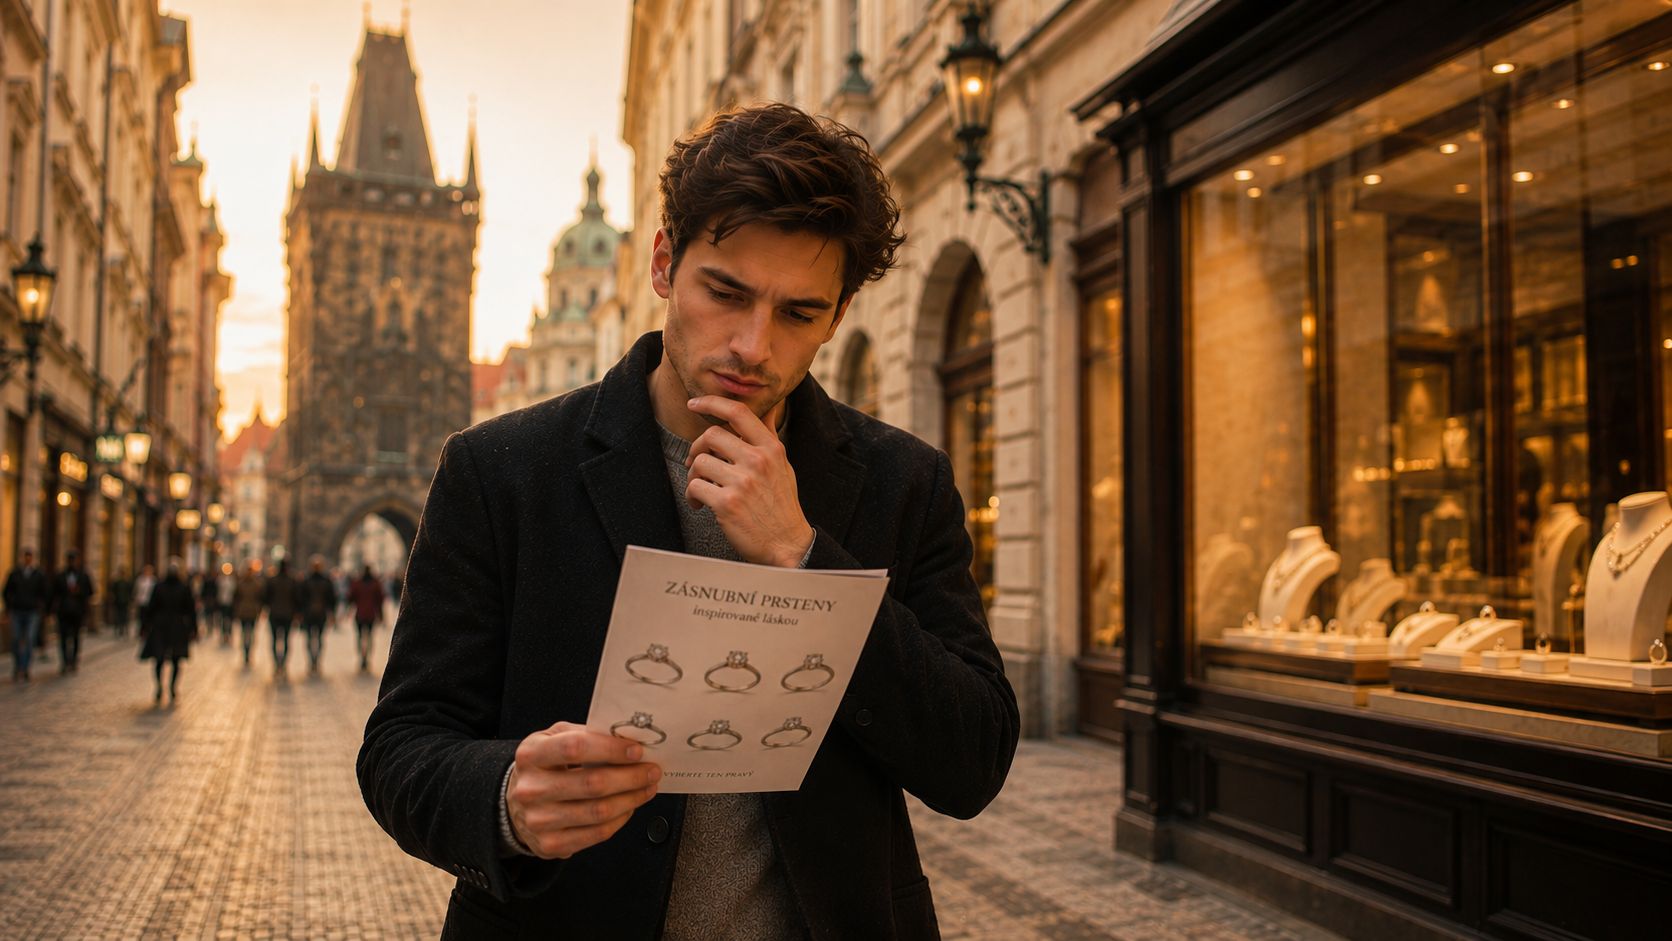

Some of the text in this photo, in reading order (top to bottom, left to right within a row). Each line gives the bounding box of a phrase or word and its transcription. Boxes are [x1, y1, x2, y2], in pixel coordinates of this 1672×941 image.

[664, 581, 836, 612] ZÁSNUBNÍ PRSTENY
[692, 605, 799, 626] inspirované láskou
